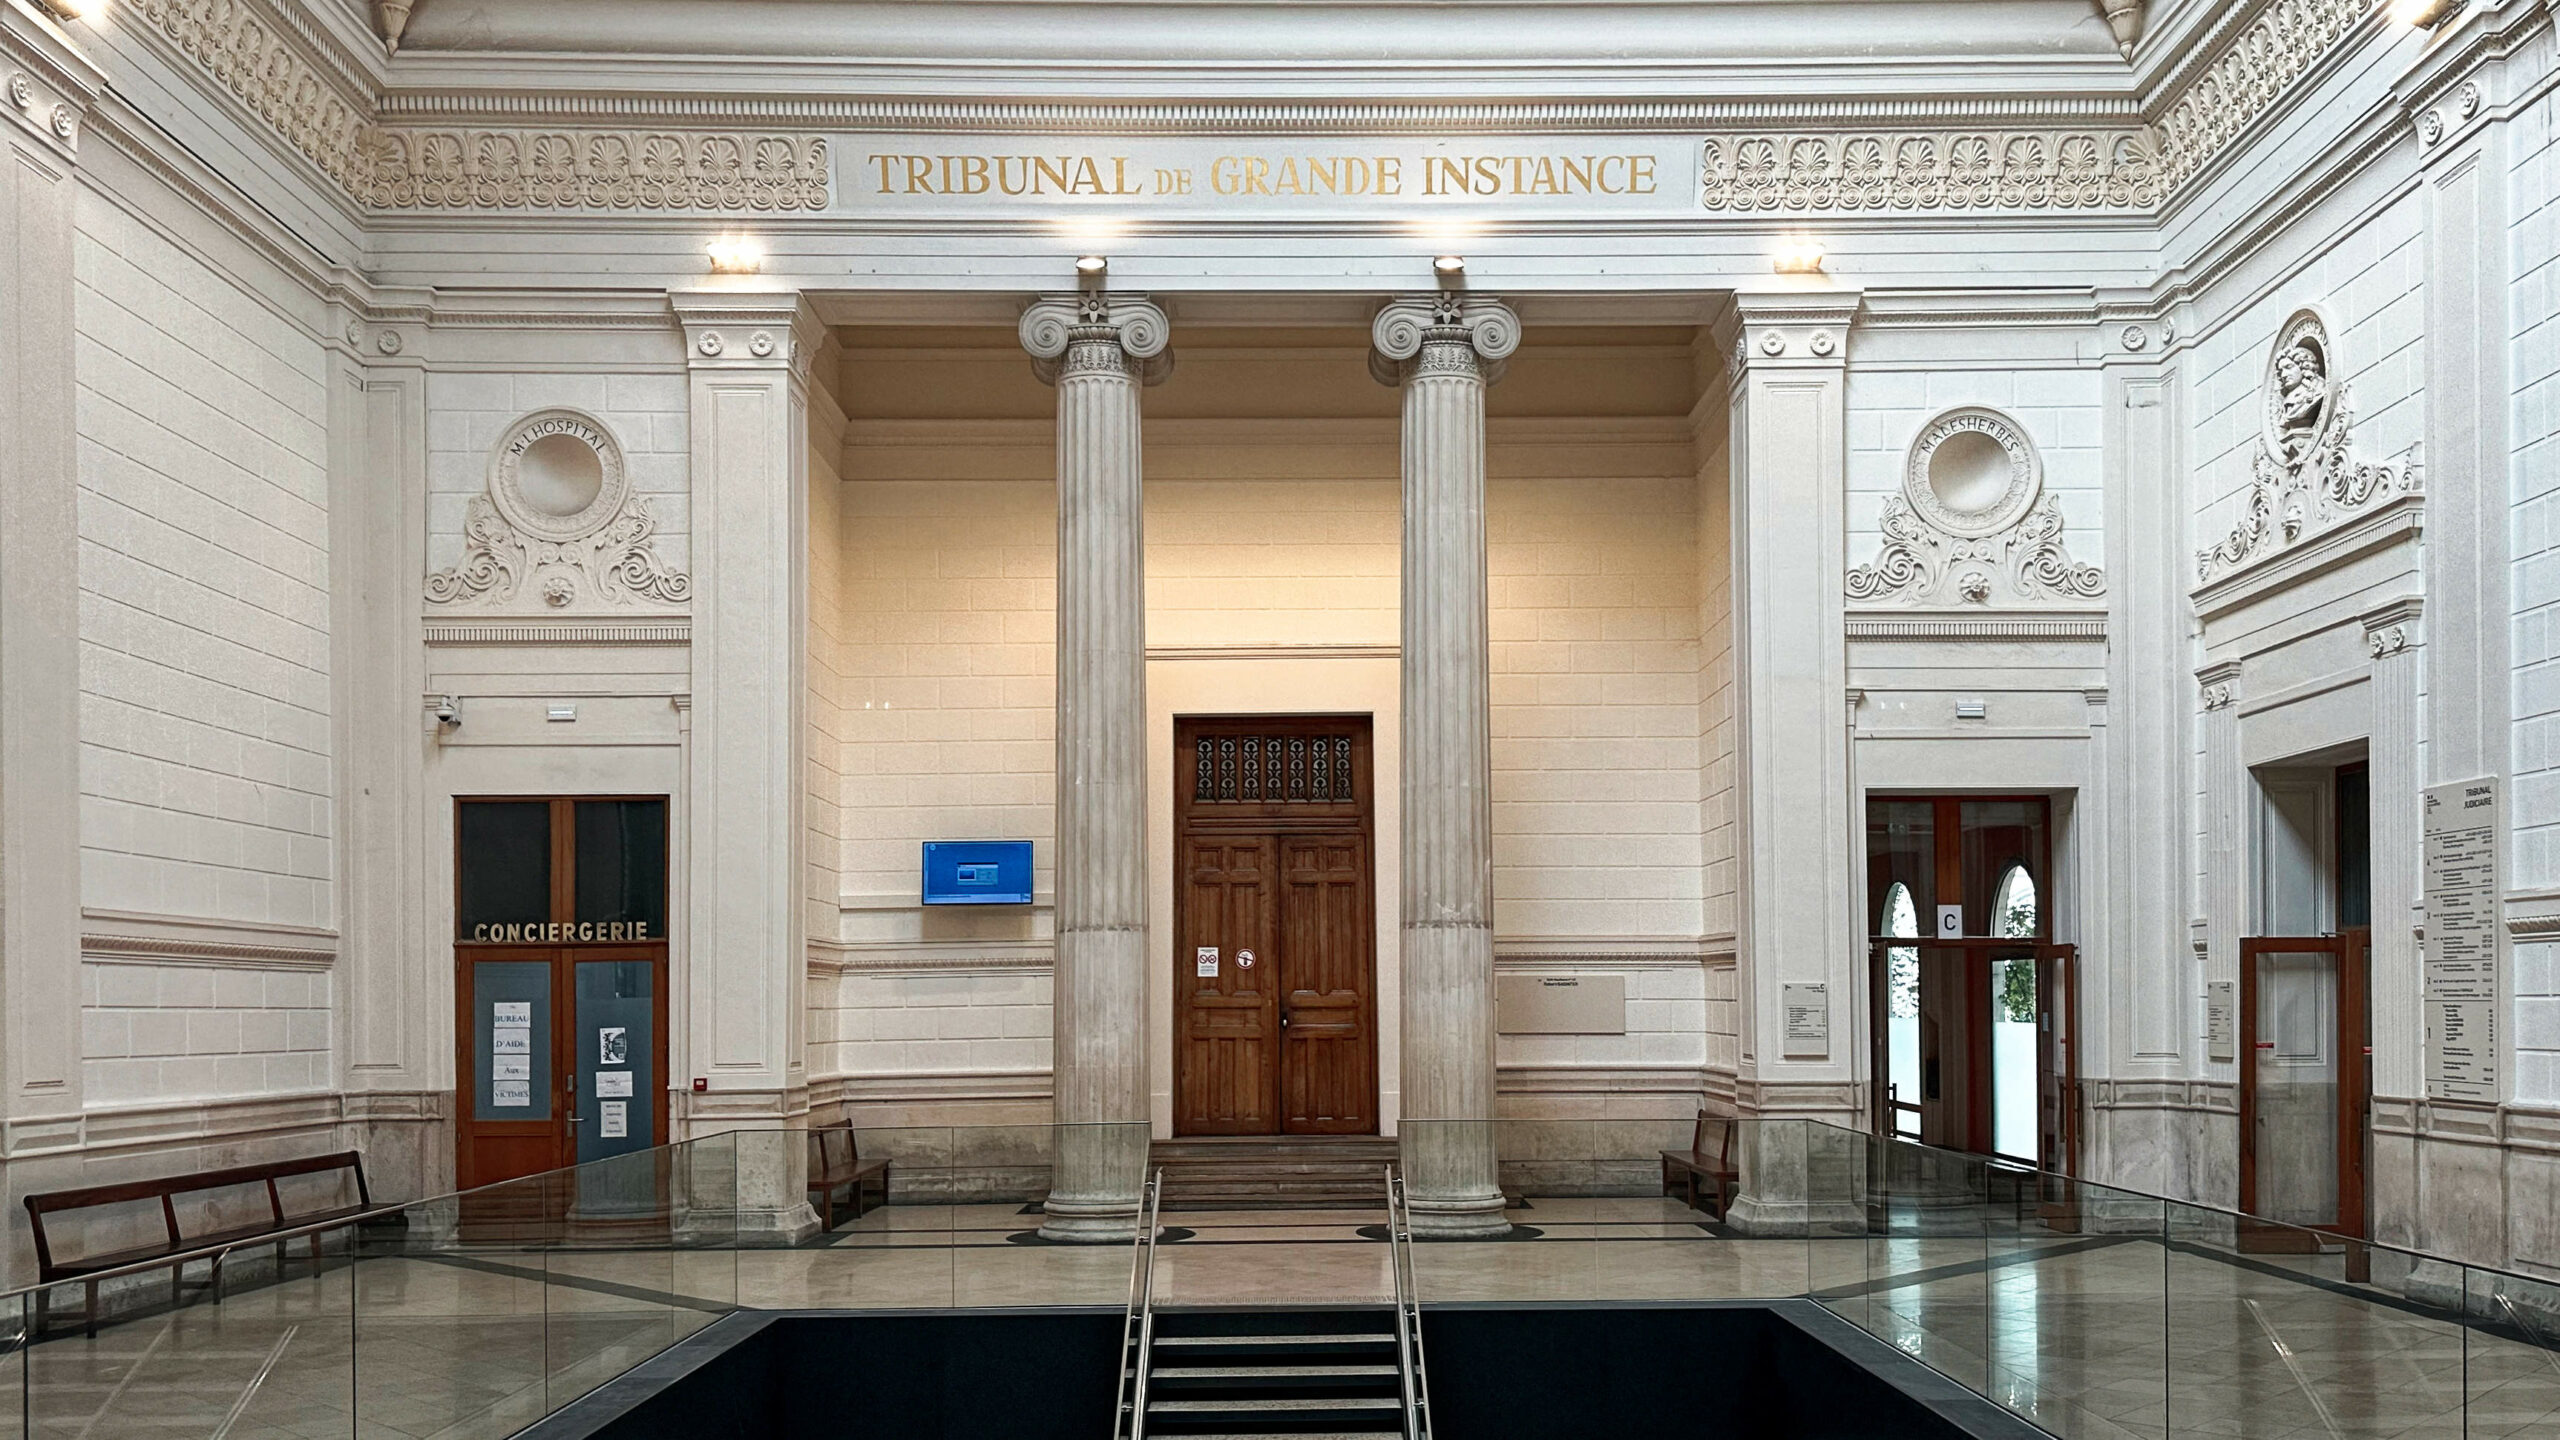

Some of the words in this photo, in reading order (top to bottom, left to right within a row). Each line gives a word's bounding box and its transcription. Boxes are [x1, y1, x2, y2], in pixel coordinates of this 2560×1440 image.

[867, 154, 1144, 196] TRIBUNAL
[1153, 168, 1193, 196] DE
[1210, 155, 1402, 197] GRANDE
[1420, 154, 1658, 196] INSTANCE
[1921, 417, 2020, 454] MALESHERBES
[2465, 786, 2492, 797] TRIBUNAL
[474, 921, 648, 943] CONCIERGERIE
[1944, 913, 1956, 931] C
[494, 1015, 529, 1023] BUREAU
